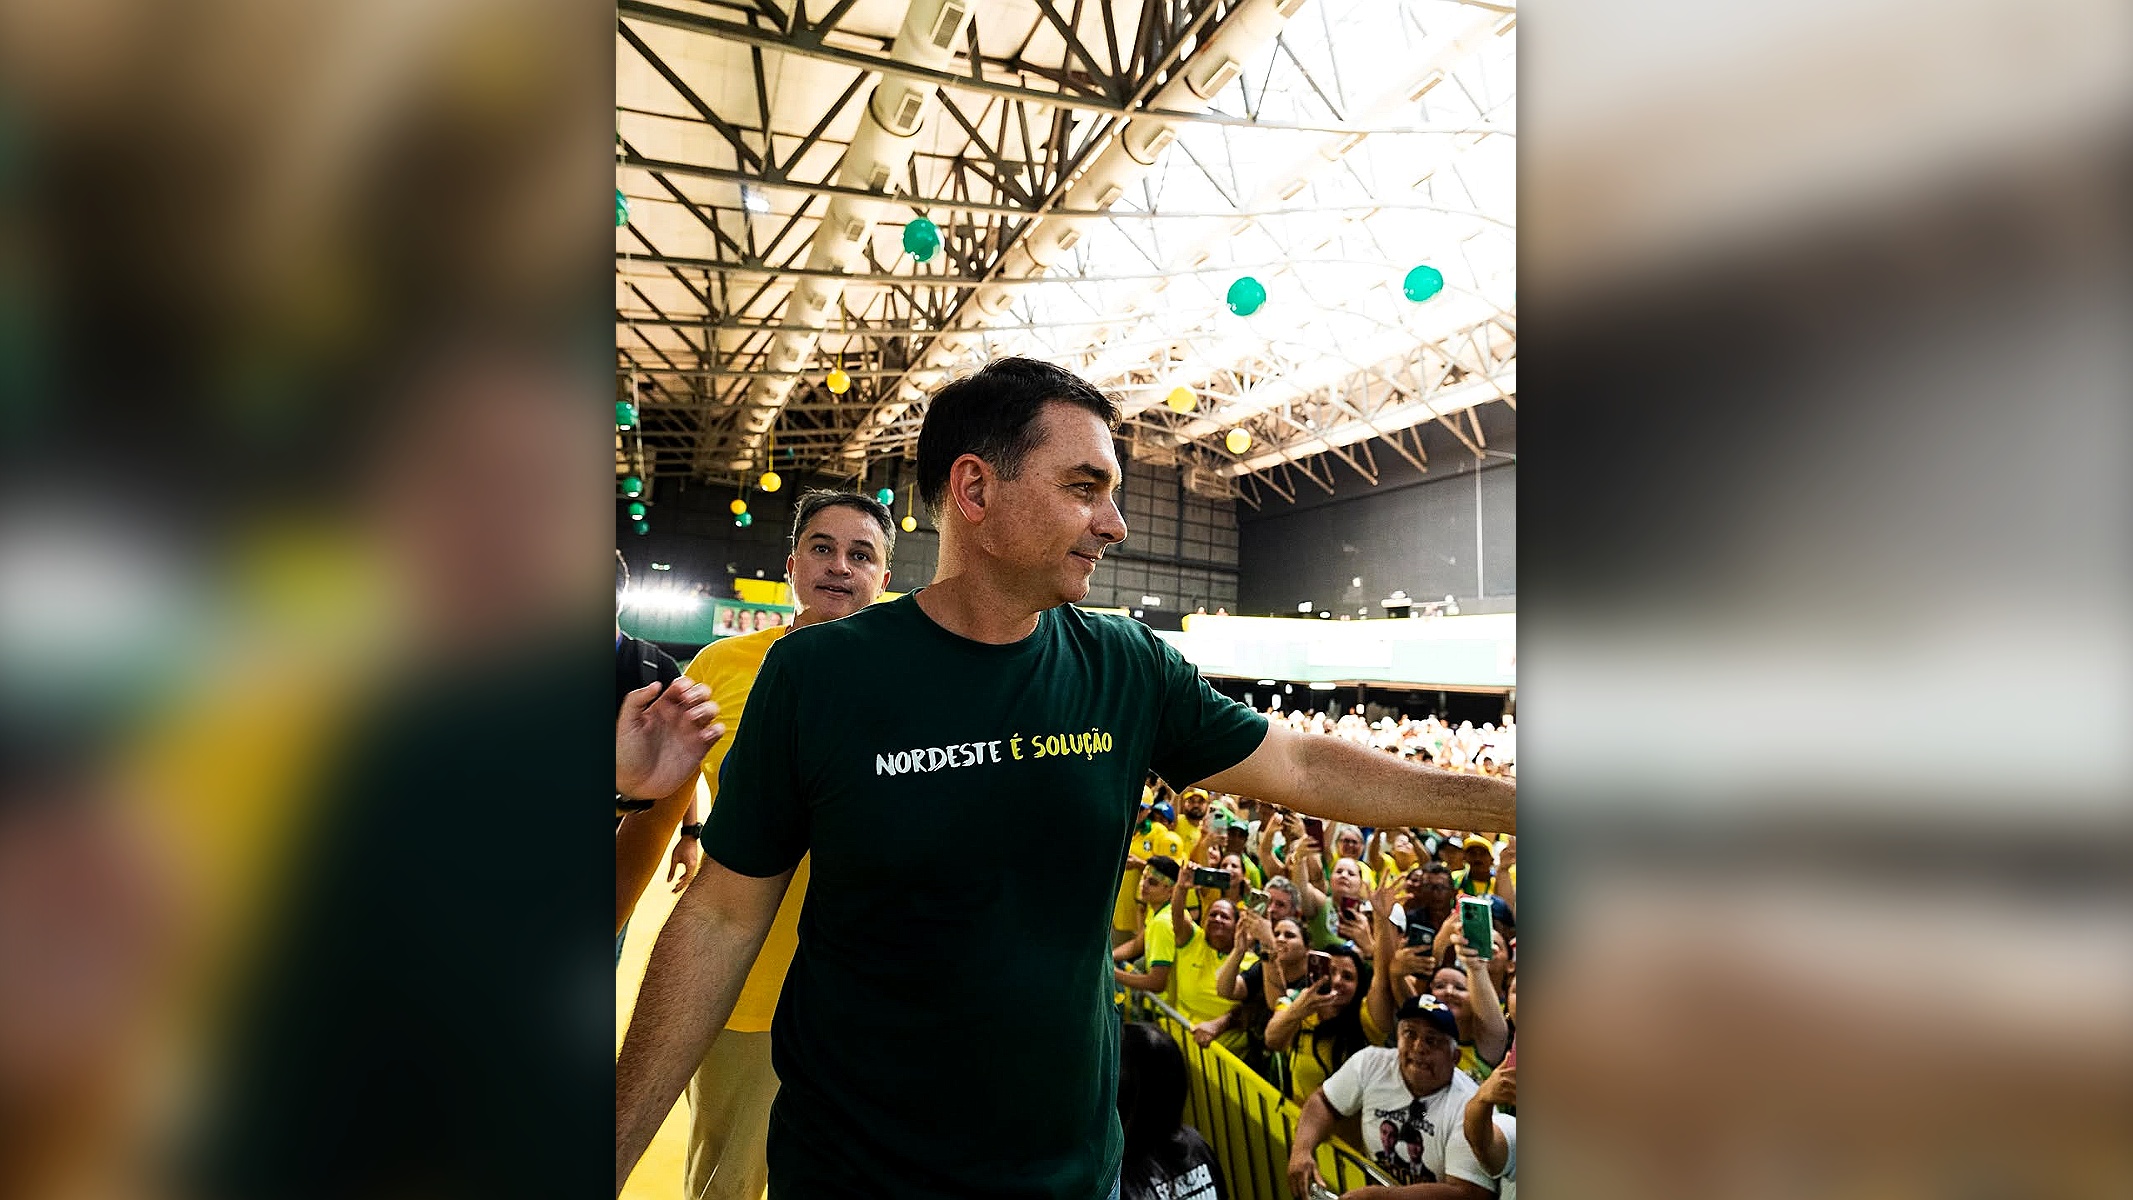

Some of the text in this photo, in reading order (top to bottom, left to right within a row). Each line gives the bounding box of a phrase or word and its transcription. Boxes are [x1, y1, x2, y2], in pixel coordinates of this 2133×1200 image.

[876, 728, 1112, 776] NORDESTE É SOLUÇÃO
